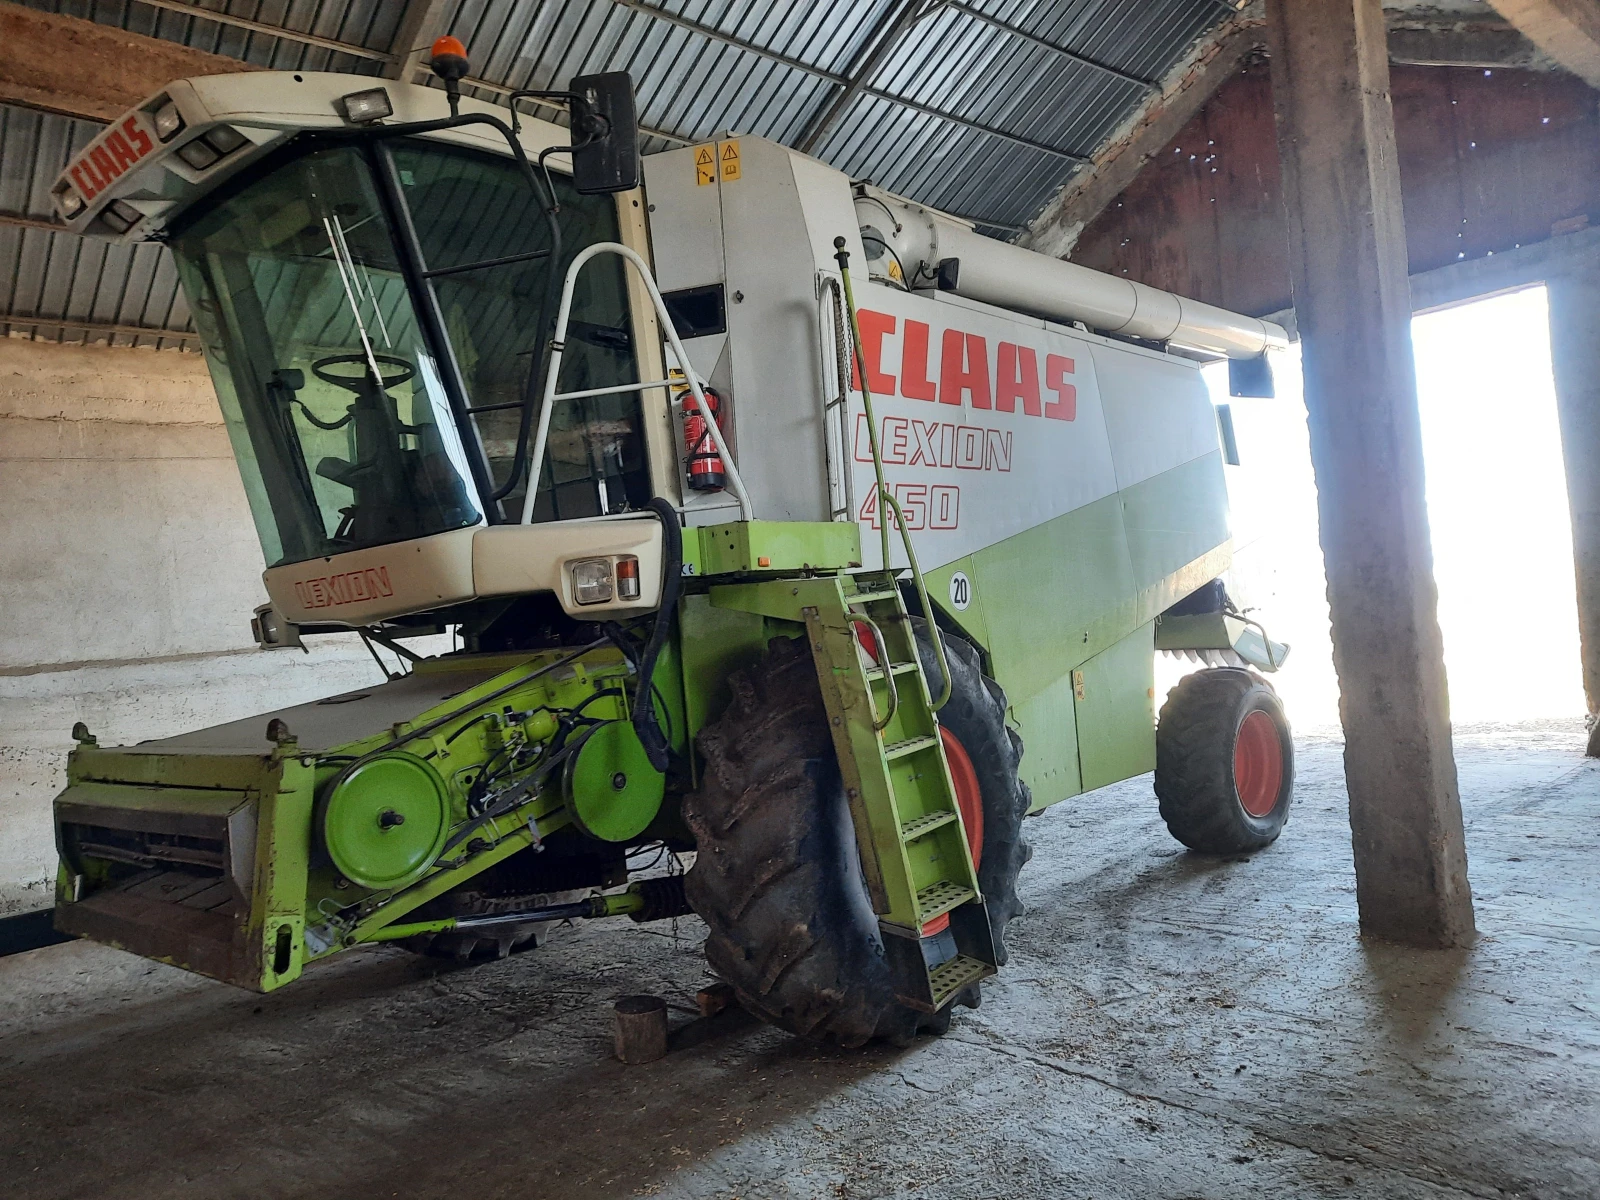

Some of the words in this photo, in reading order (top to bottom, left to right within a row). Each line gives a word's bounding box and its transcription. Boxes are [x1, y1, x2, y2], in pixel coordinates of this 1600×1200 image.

[71, 115, 154, 200] CLAAS
[853, 308, 1077, 422] CLAAS
[855, 413, 1013, 473] LEXION
[860, 482, 960, 531] 450
[294, 566, 394, 609] LEXION
[953, 577, 968, 604] 20
